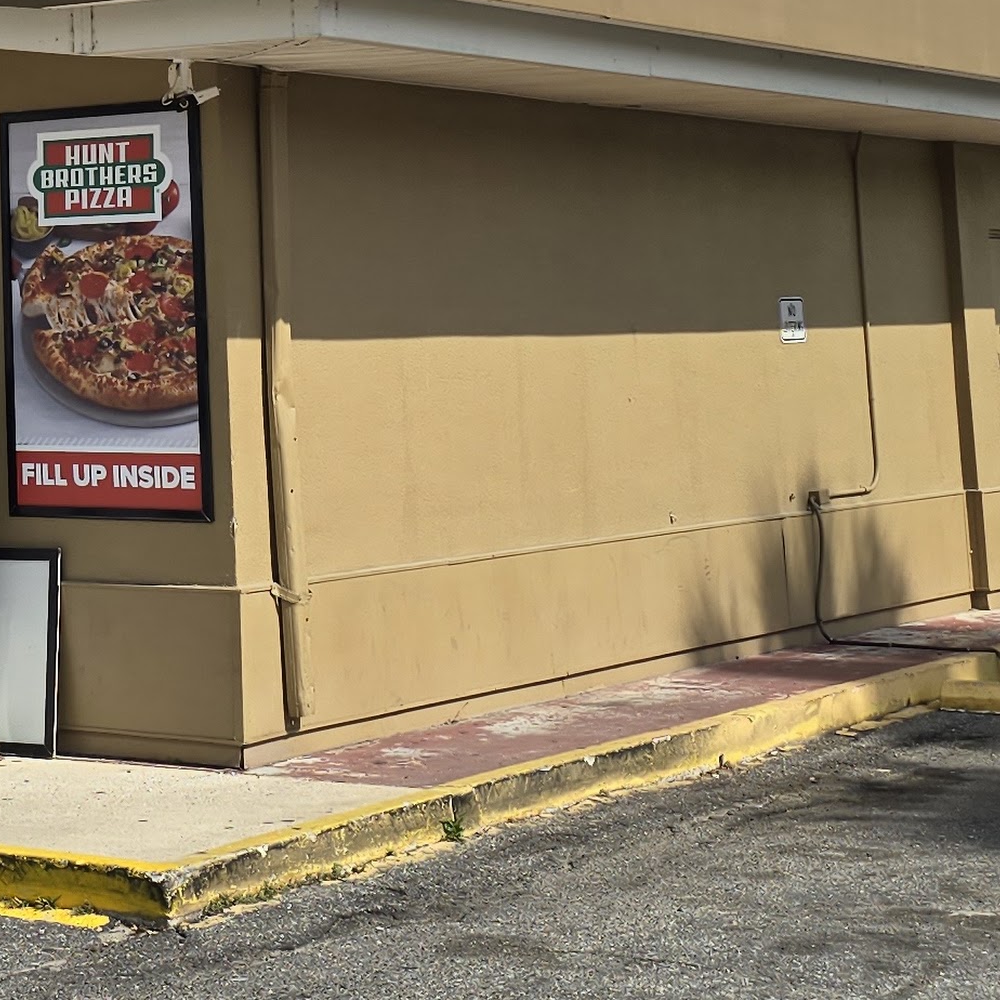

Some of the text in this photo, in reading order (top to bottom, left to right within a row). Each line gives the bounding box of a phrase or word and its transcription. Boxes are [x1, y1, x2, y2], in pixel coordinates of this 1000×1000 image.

[64, 141, 130, 166] HUNT
[40, 163, 158, 189] BROTHERS
[64, 186, 132, 211] PIZZA
[22, 463, 196, 490] FILL UP INSIDE
